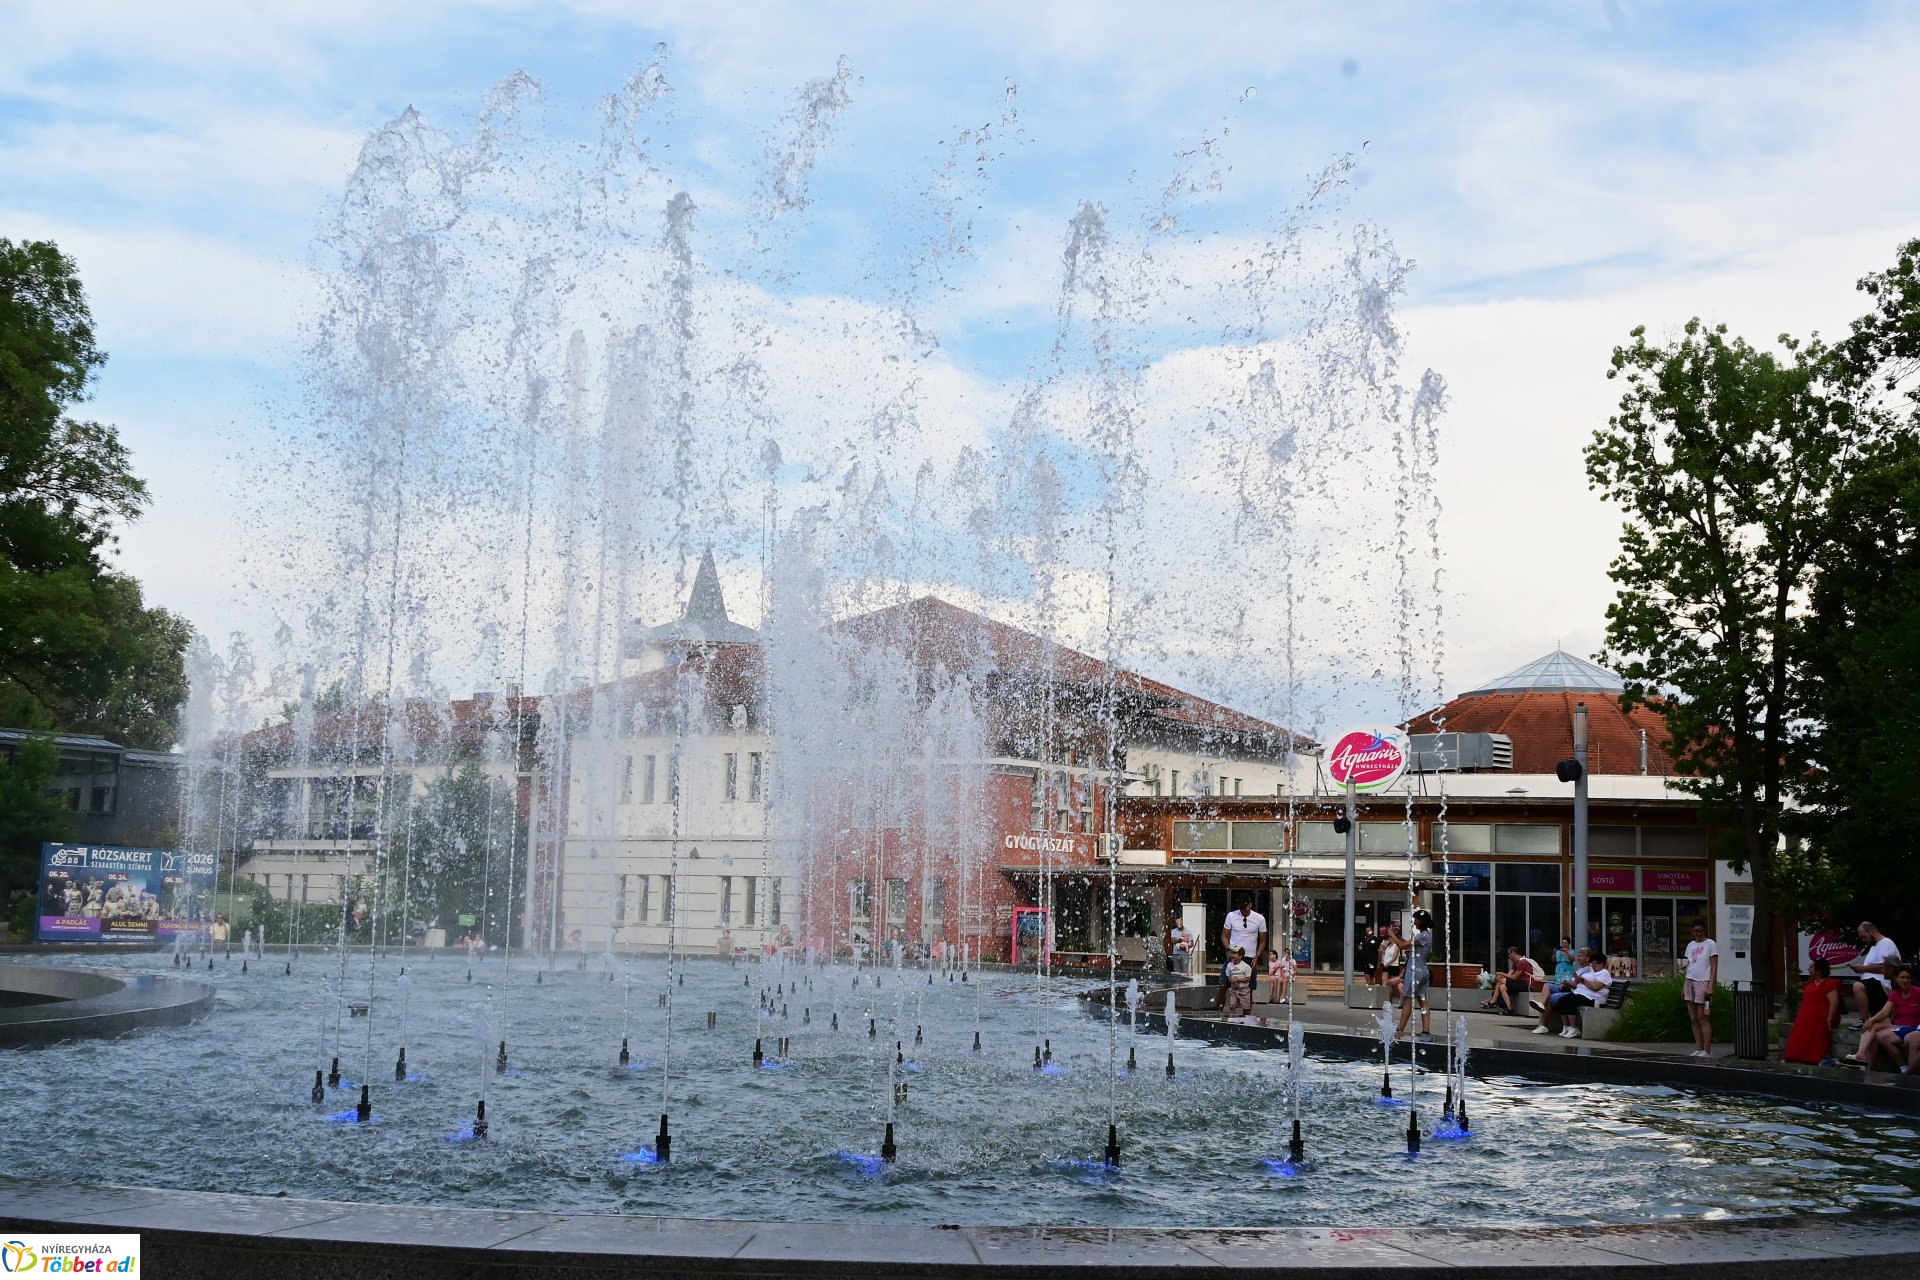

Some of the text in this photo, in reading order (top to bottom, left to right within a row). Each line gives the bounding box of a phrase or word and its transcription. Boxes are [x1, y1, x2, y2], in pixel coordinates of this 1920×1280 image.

[1330, 744, 1400, 783] Aquarius
[1005, 832, 1075, 853] GYÓGYÁSZAT
[91, 848, 152, 863] RÓZSAKERT
[187, 853, 214, 865] 2026
